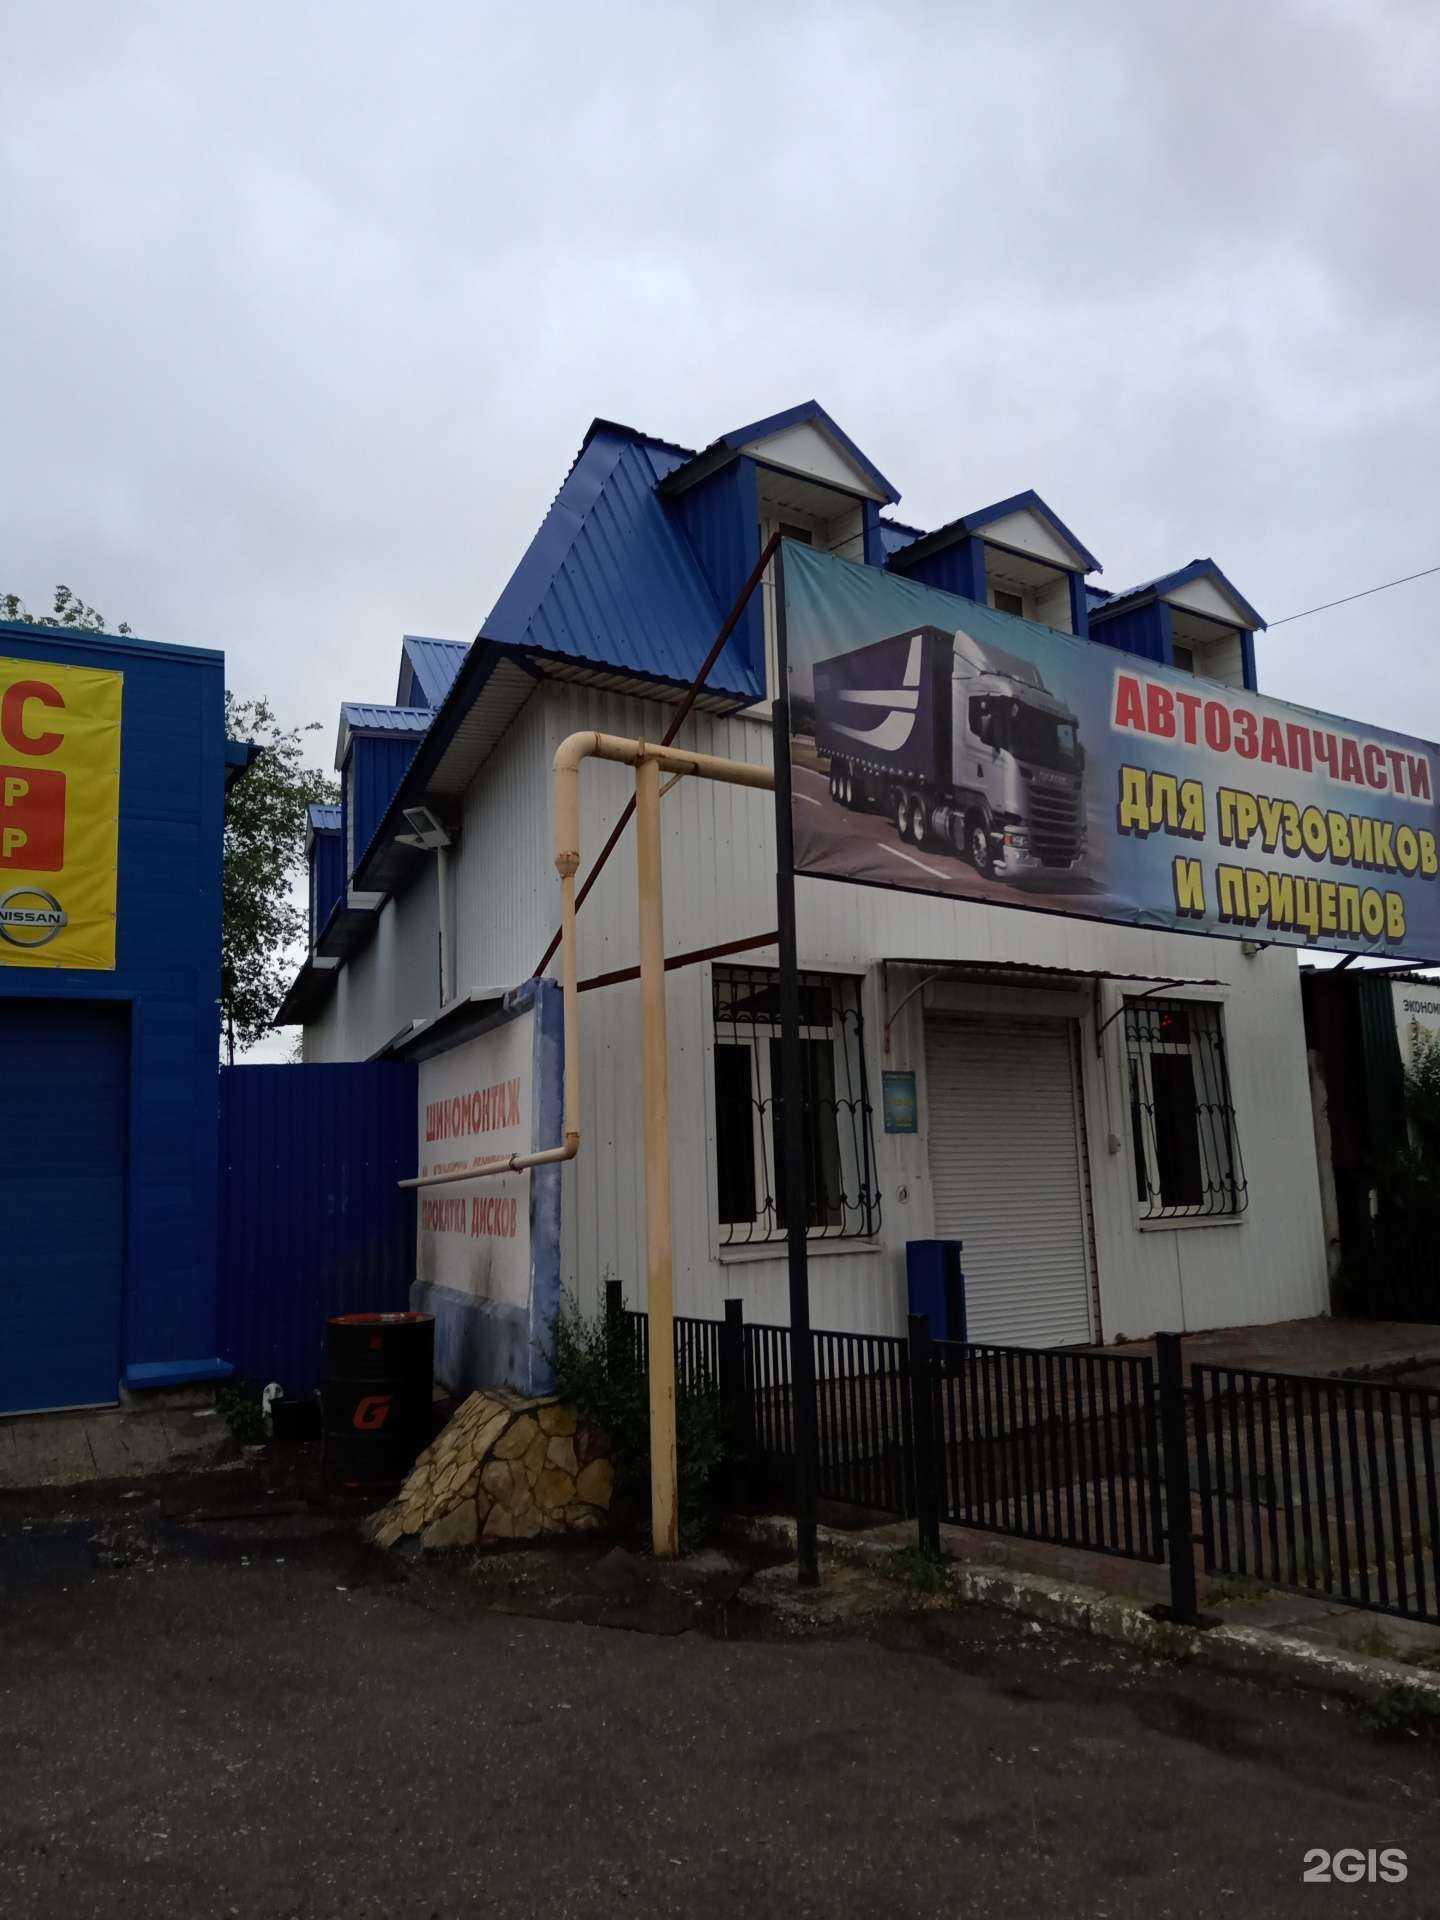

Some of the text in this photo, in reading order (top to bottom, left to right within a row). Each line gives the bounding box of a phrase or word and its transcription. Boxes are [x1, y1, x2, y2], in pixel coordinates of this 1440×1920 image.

[1115, 675, 1432, 801] АВТОЗАПЧАСТИ
[1117, 764, 1440, 881] ДЛЯ ГРУЗОВИКОВ
[0, 911, 61, 924] NISSAN
[1172, 855, 1406, 945] И ПРИЦЕПОВ
[471, 1197, 518, 1239] ДИСКОВ
